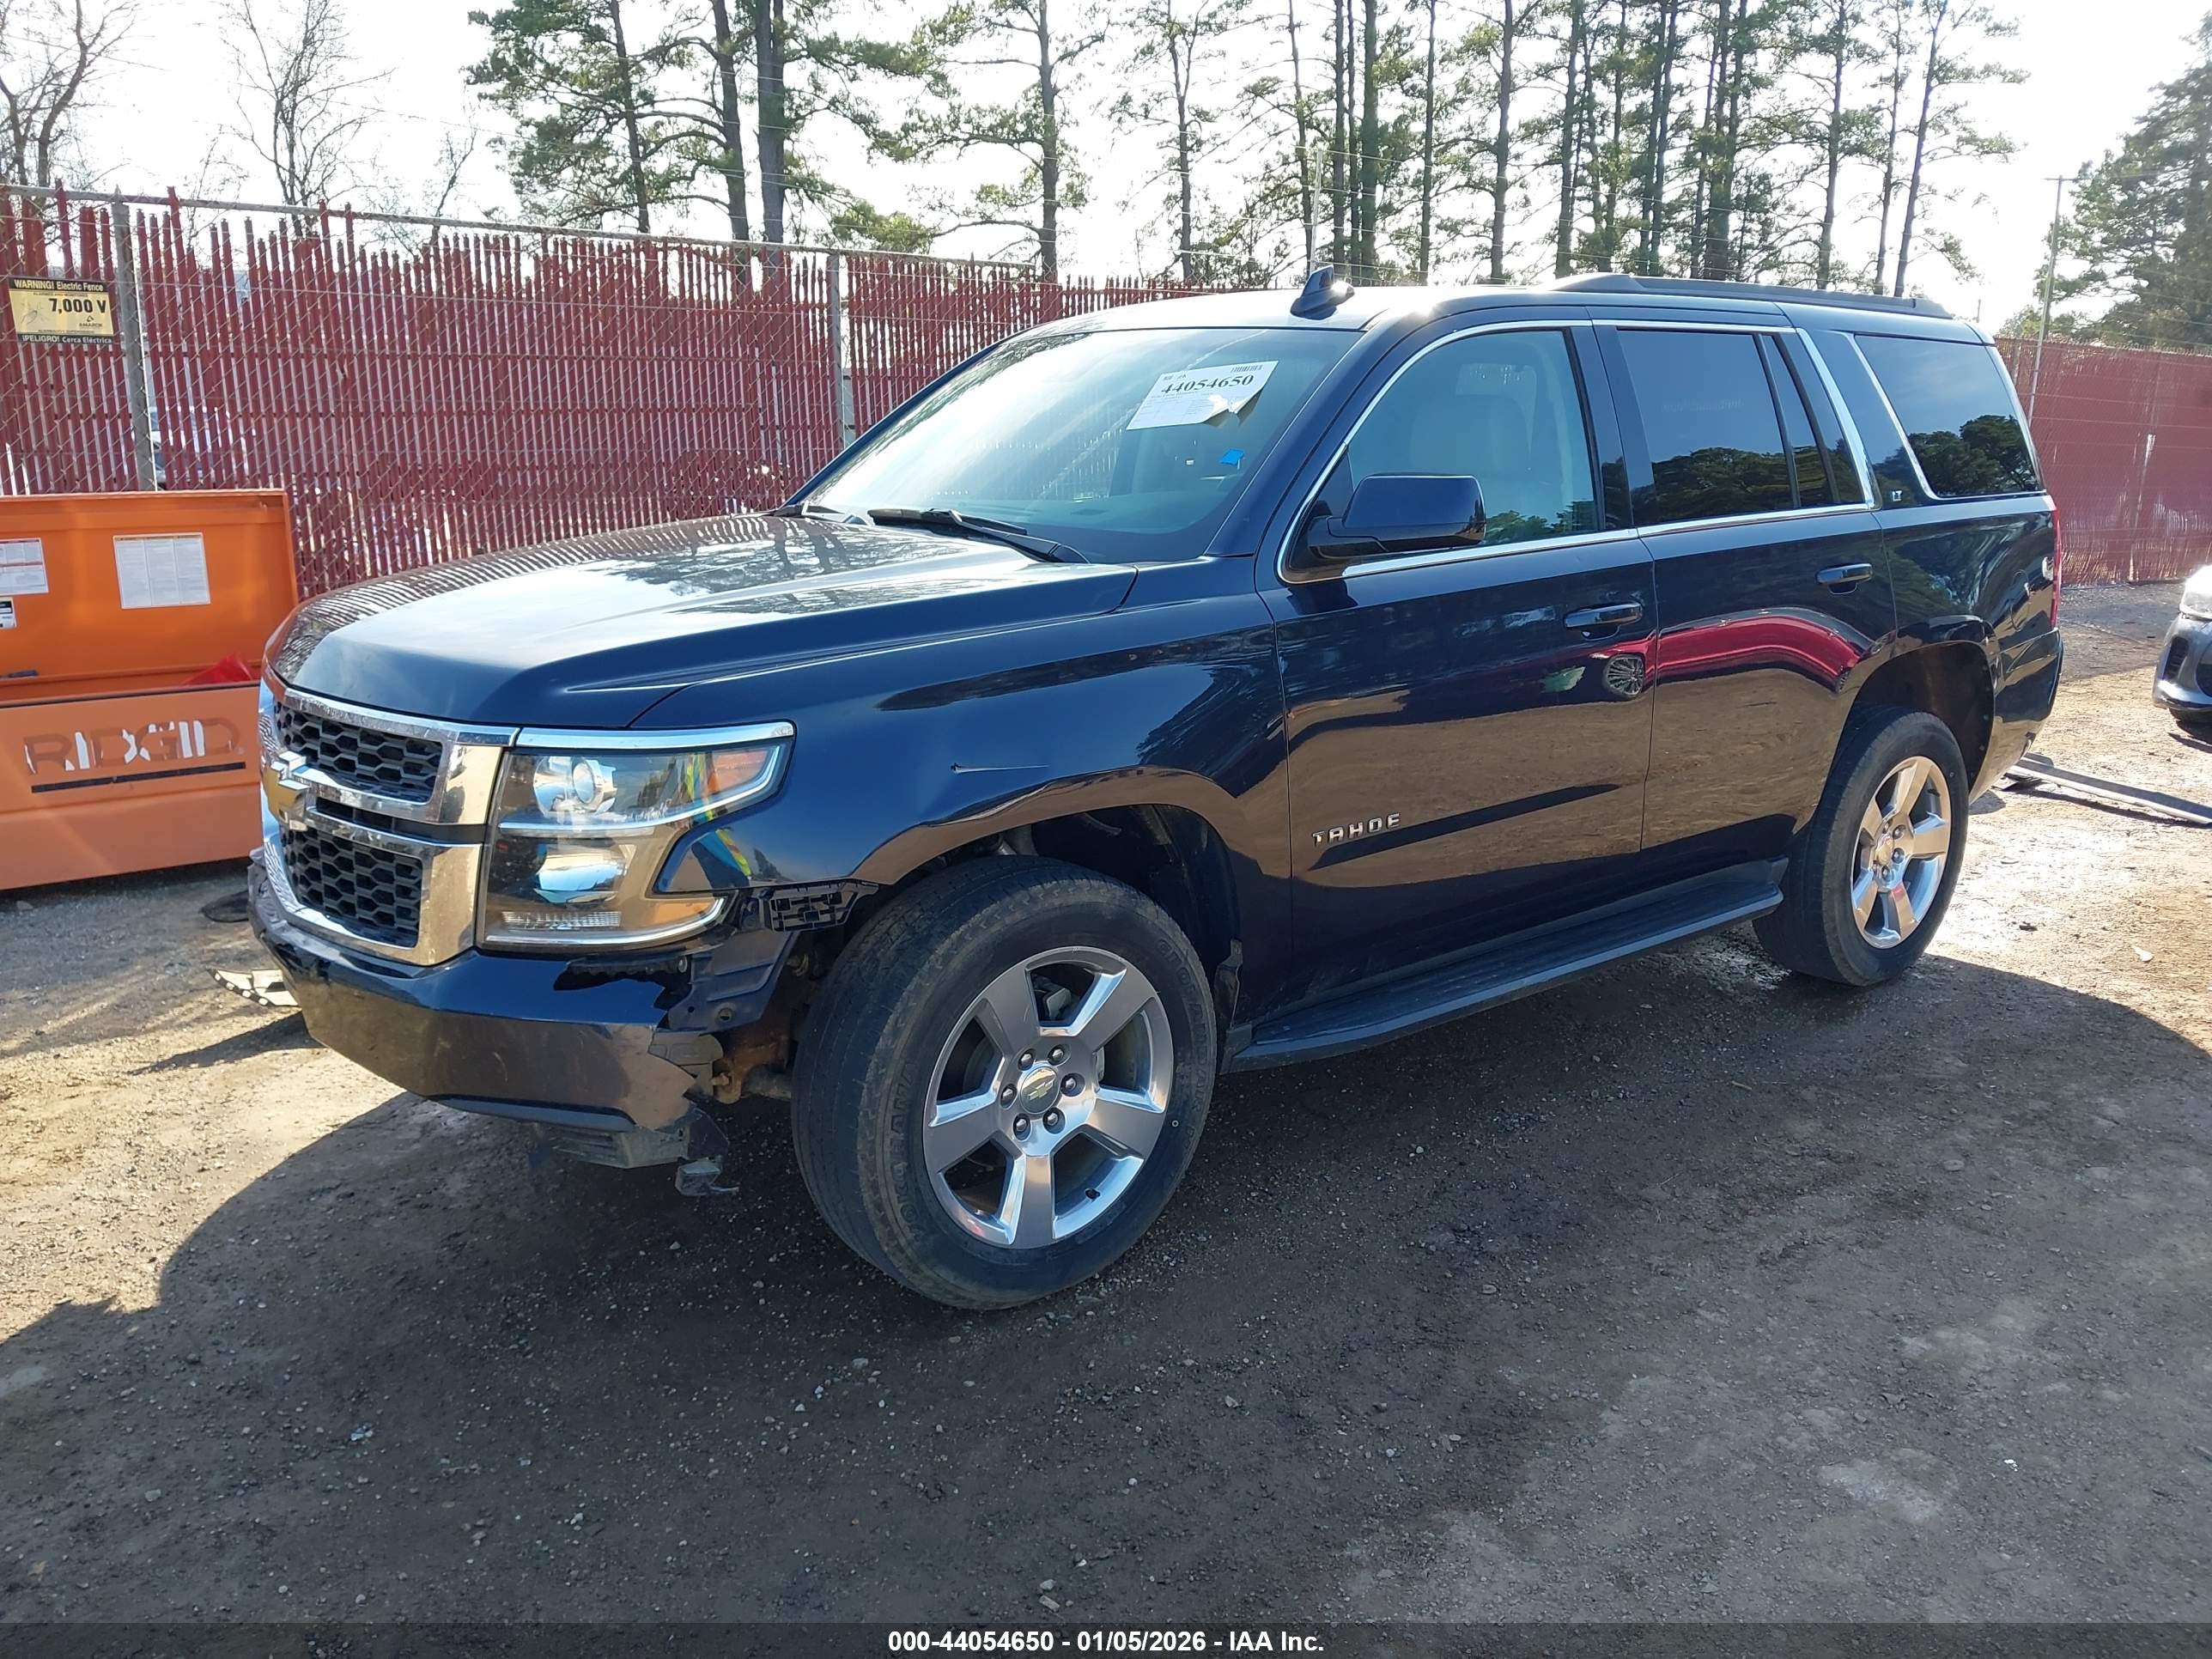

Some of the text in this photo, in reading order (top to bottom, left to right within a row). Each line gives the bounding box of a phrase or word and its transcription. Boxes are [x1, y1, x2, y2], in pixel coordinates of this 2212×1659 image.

[14, 279, 104, 292] WARNING! Electric Fence
[48, 298, 106, 314] 7,000 V
[1161, 374, 1255, 394] 44054650
[1892, 490, 1903, 502] LT
[1312, 813, 1401, 847] TAHOE
